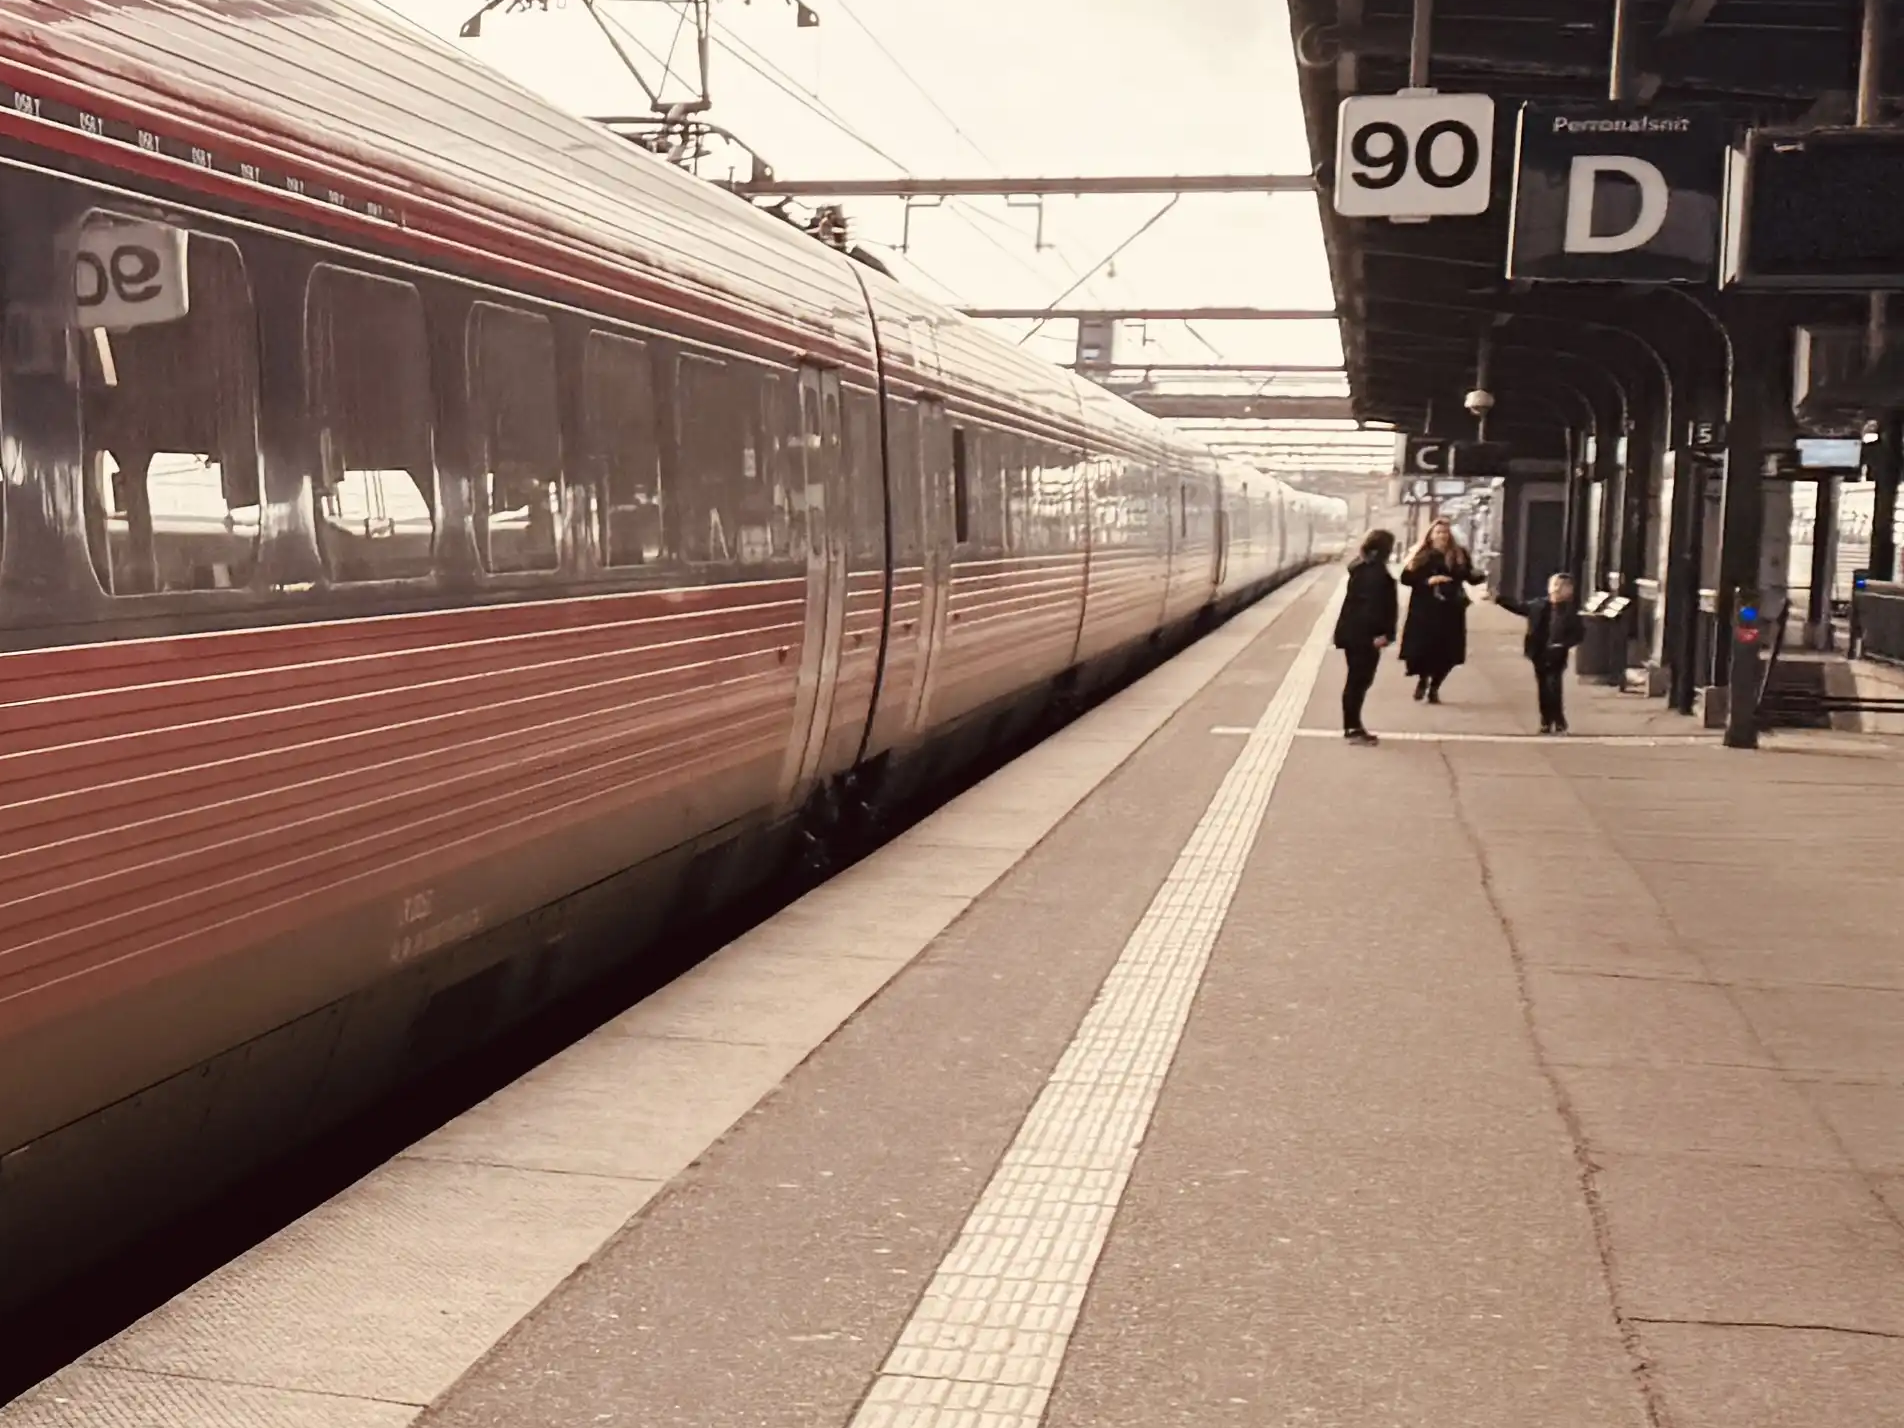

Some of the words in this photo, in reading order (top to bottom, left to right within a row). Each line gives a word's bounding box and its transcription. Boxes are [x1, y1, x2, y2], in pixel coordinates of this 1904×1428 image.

[1351, 120, 1480, 189] 90
[1564, 155, 1669, 253] D
[1416, 445, 1439, 470] C
